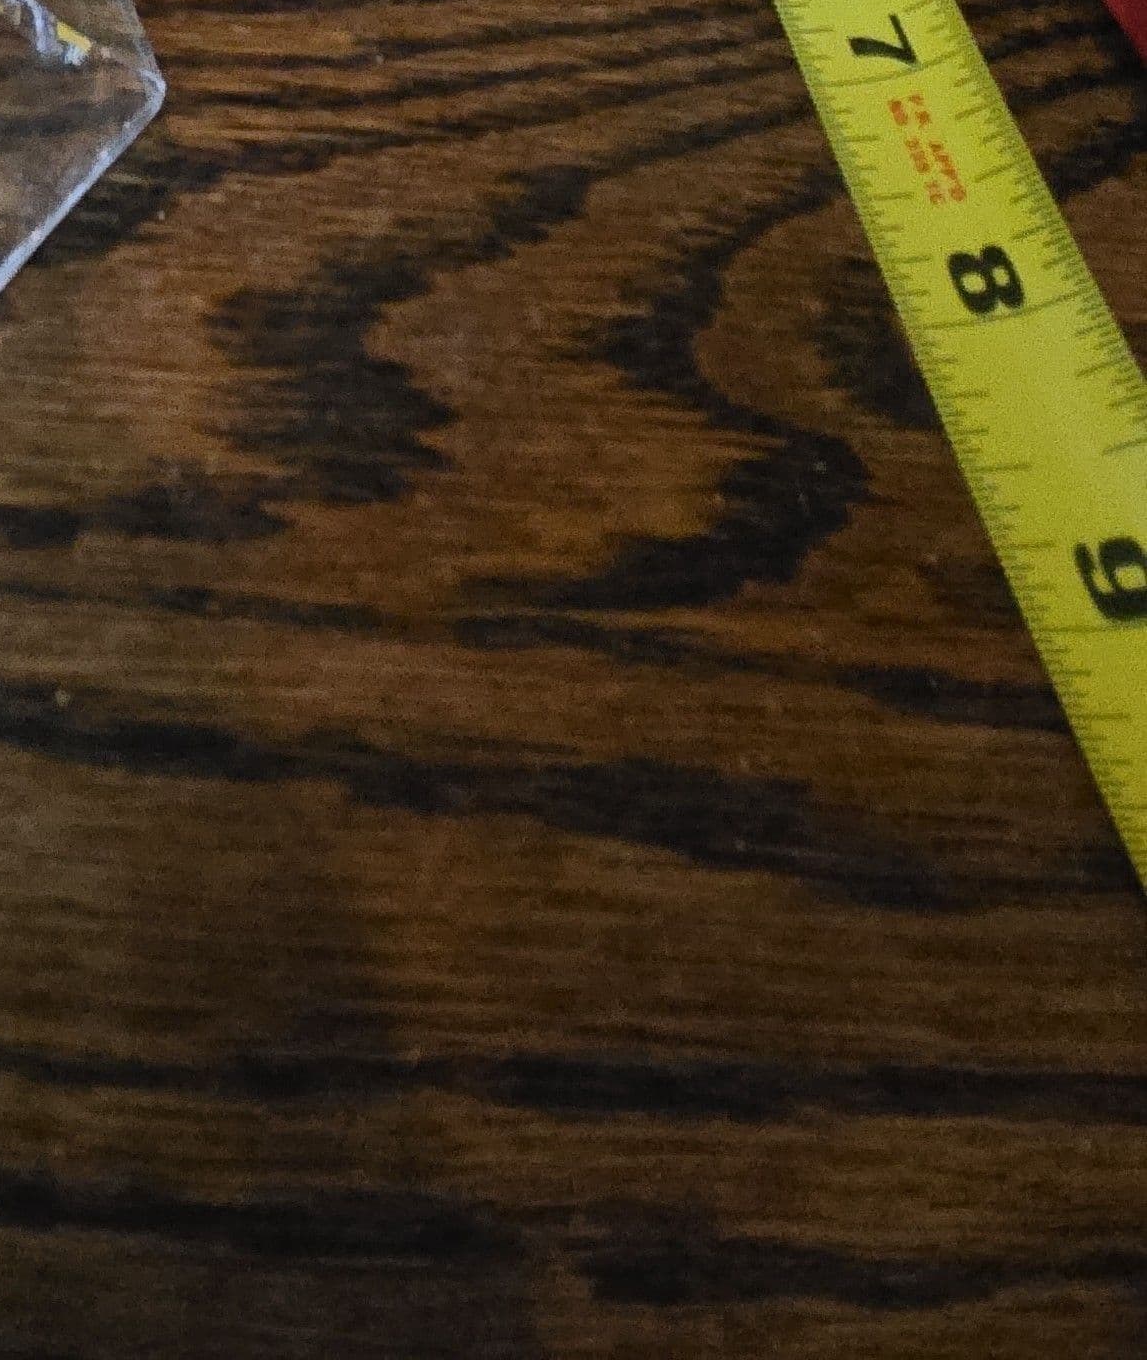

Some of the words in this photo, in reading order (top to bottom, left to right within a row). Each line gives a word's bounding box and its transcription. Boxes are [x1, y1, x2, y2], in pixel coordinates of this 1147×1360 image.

[849, 13, 918, 68] 7
[948, 244, 1025, 315] 8
[1074, 536, 1147, 621] 9
